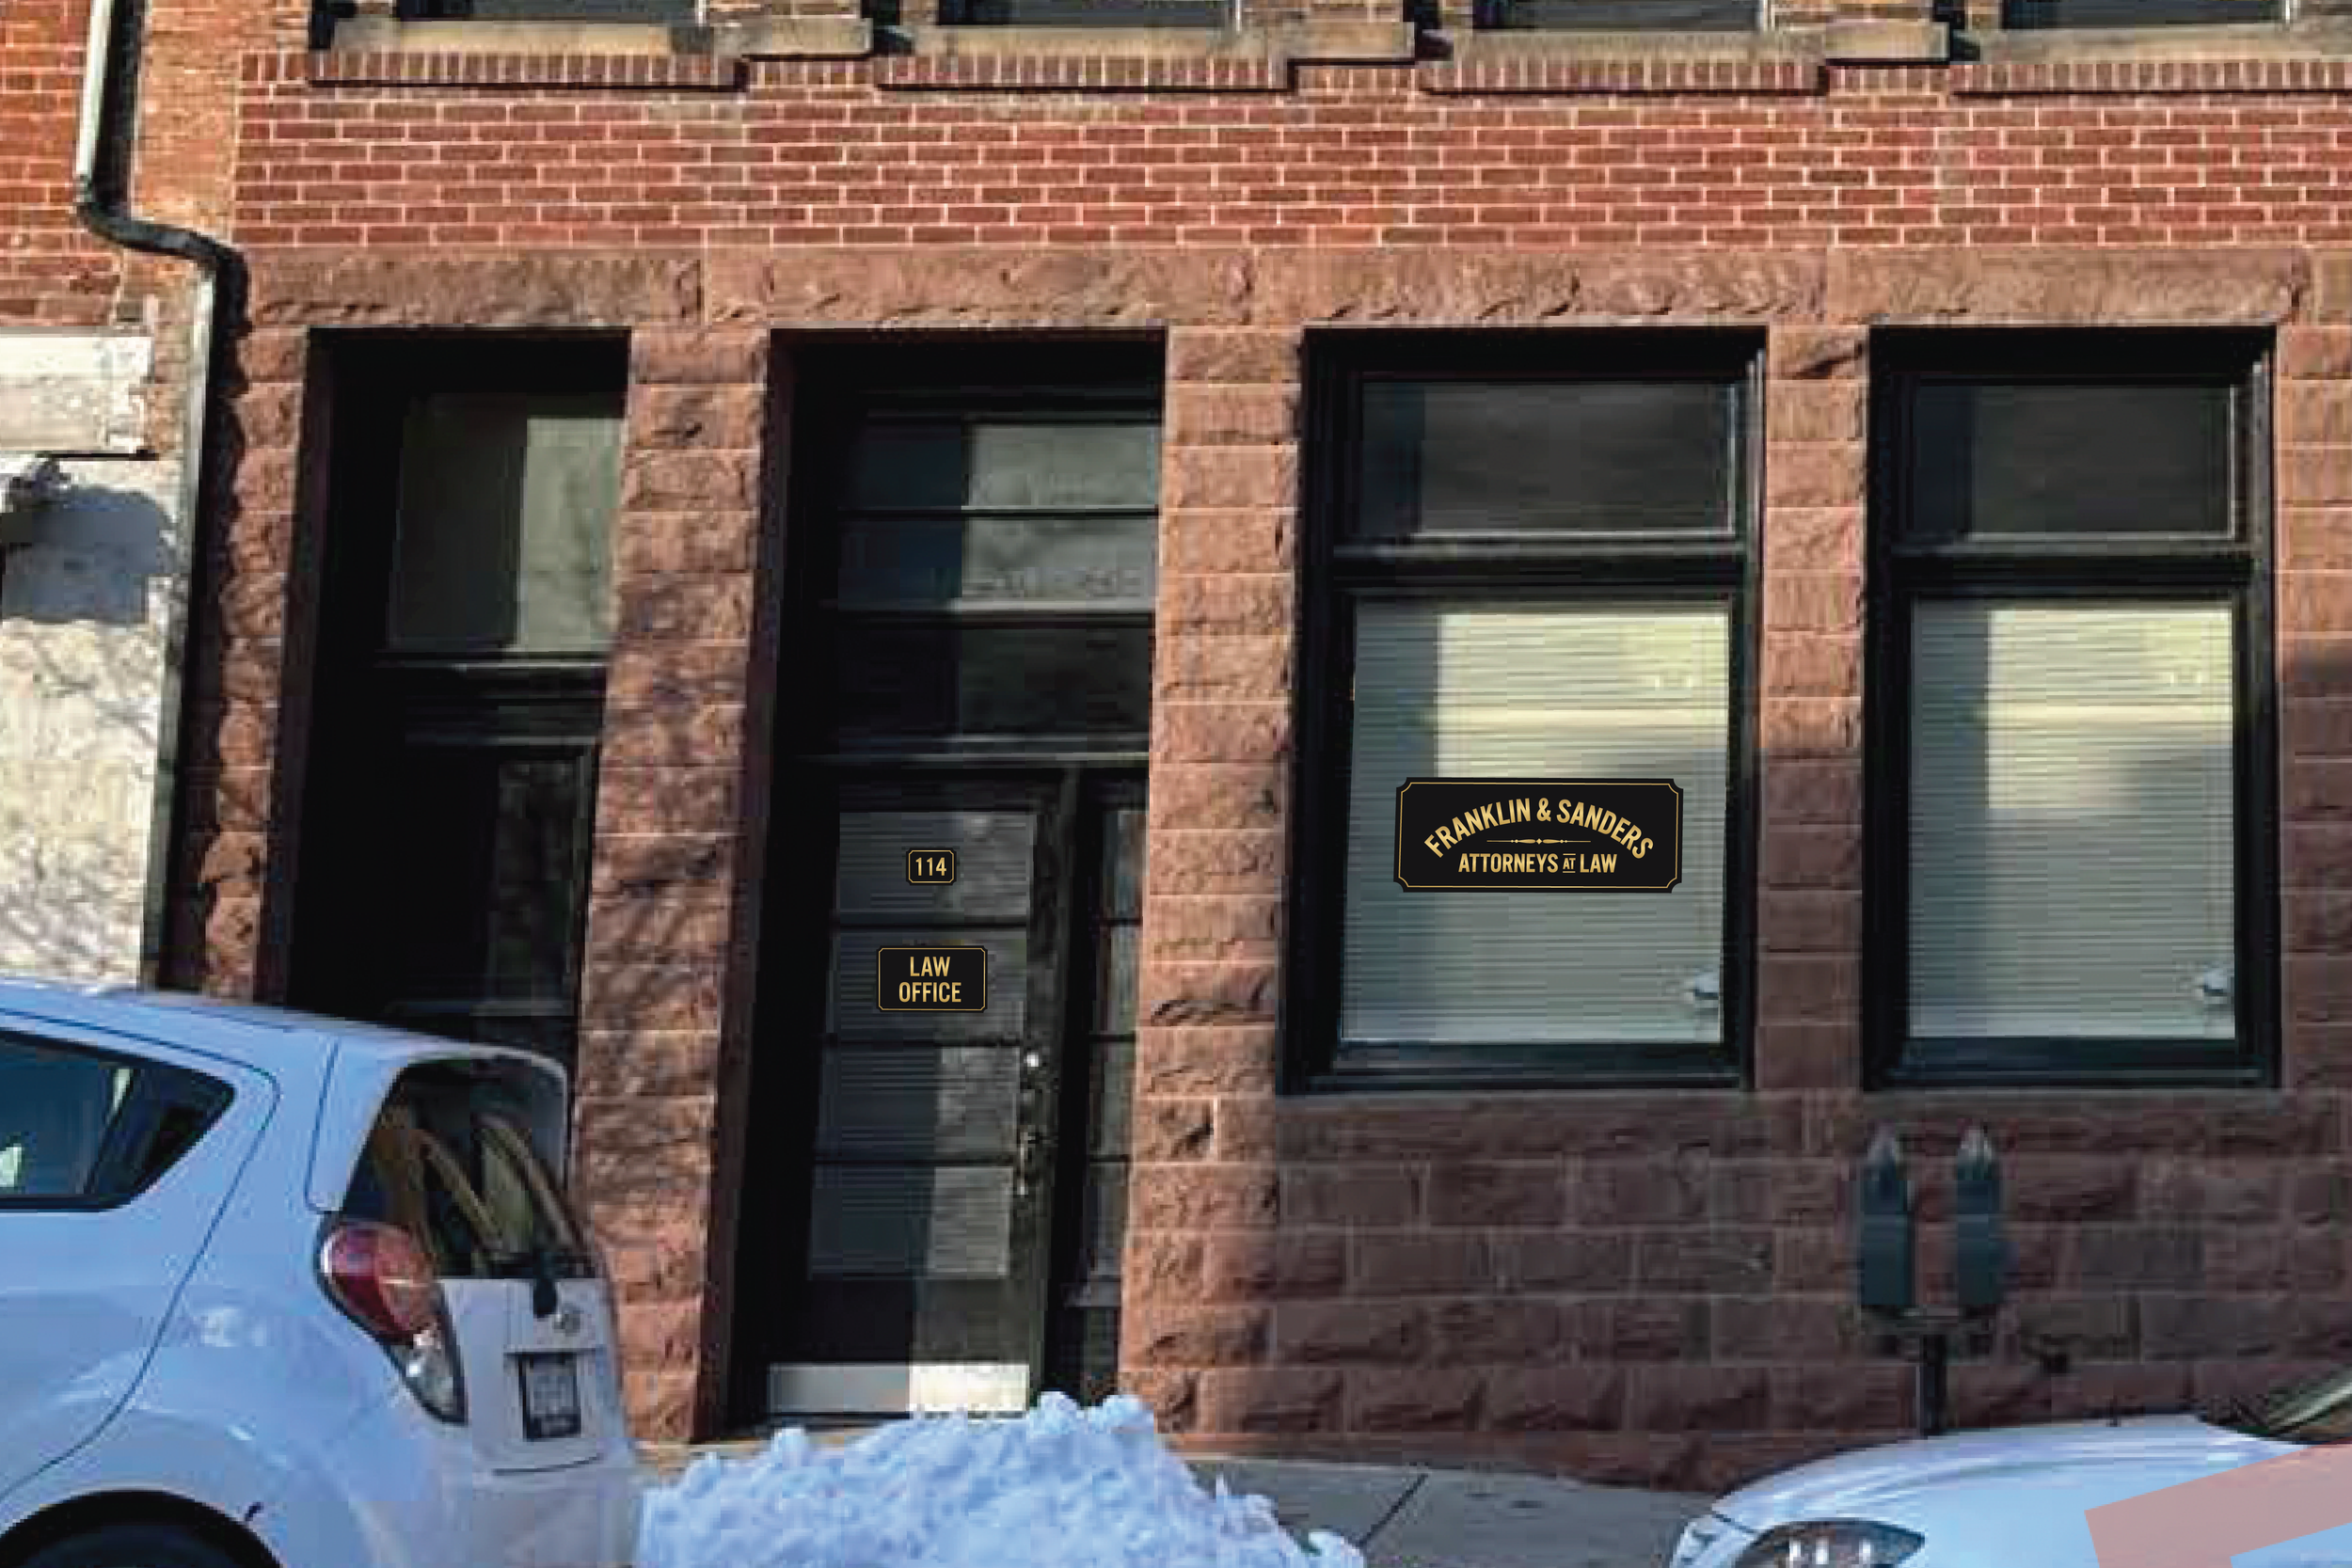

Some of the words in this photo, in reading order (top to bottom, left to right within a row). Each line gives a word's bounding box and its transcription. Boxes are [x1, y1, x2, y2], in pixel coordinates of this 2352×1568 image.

[1423, 798, 1532, 858] FRANKLIN
[1536, 797, 1551, 822] &
[1556, 799, 1654, 859] SANDERS
[915, 857, 947, 877] 114
[1457, 852, 1559, 874] ATTORNEYS
[1562, 857, 1577, 870] AT
[1580, 853, 1618, 874] LAW
[910, 956, 951, 977] LAW
[898, 981, 962, 1003] OFFICE
